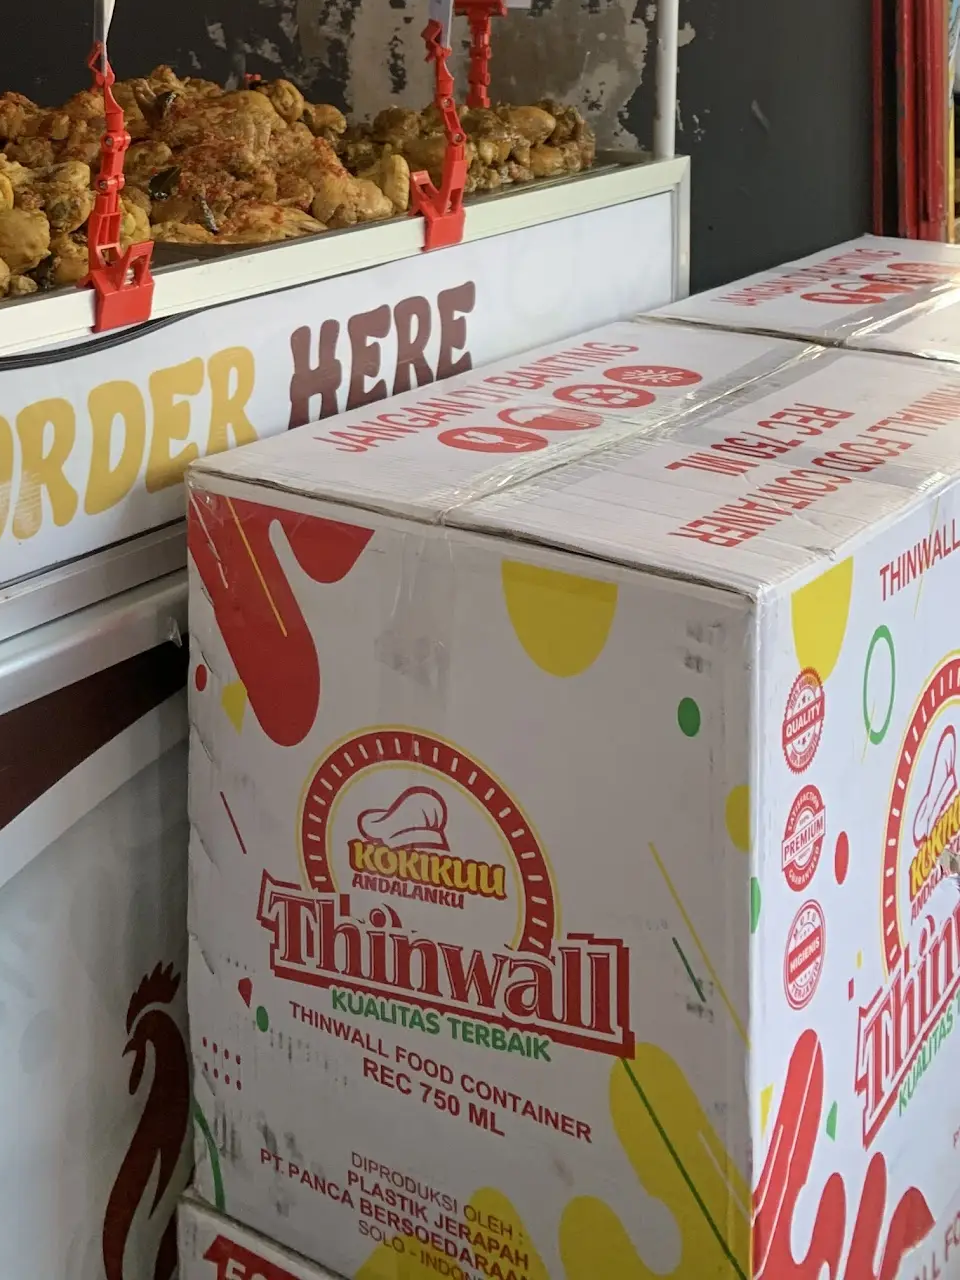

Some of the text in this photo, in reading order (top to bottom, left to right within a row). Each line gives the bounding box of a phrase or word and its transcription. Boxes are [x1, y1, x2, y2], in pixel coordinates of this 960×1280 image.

[288, 280, 476, 430] HERE
[313, 341, 639, 453] JANGAN DI BANTING
[664, 402, 856, 477] REC 750 ML
[811, 434, 914, 473] FOOD
[668, 469, 853, 548] CONTAINER
[879, 518, 960, 602] THINWALL
[786, 702, 822, 739] QUALITY
[348, 838, 508, 900] KOKIKUU
[784, 815, 824, 861] PREMIUM
[352, 872, 465, 910] ANDALANKU
[262, 888, 628, 1042] Thinwall
[331, 987, 552, 1063] KUALITAS TERBAIK
[289, 1000, 390, 1059] THINWALL
[395, 1045, 454, 1085] FOOD
[460, 1074, 593, 1144] CONTAINER
[363, 1057, 412, 1095] REC
[419, 1081, 461, 1116] 750
[468, 1102, 506, 1138] ML
[259, 1148, 529, 1280] PT. PANCA BERSOEDARAA
[346, 1169, 529, 1271] PLASTIK JERAPAH
[350, 1151, 458, 1215] DIPRODUKSI
[463, 1205, 514, 1237] OLEH
[357, 1220, 405, 1255] SOLO
